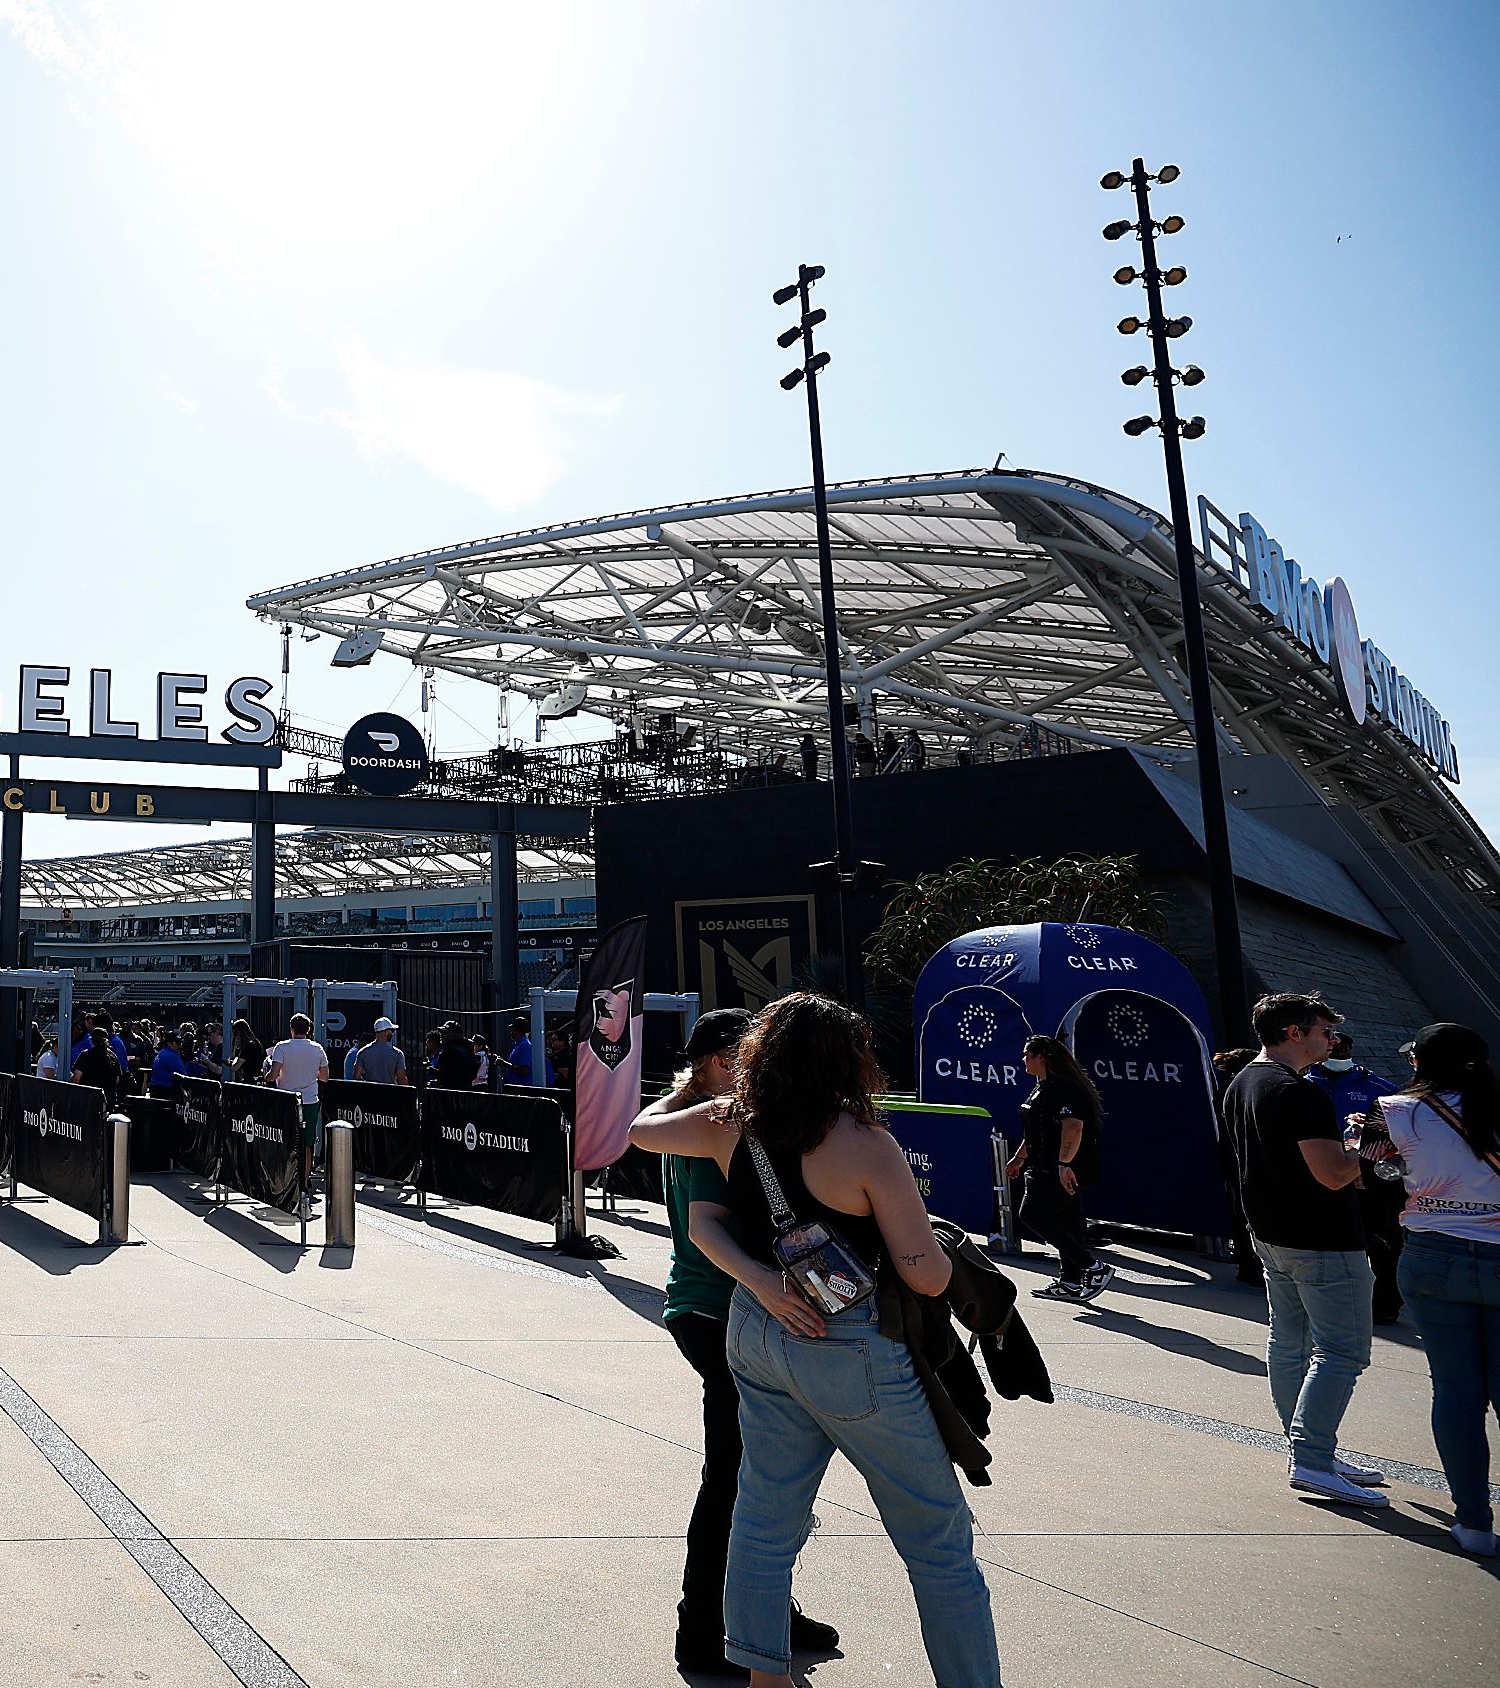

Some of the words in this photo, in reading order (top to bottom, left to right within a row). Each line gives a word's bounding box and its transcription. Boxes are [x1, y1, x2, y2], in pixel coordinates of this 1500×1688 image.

[1239, 512, 1330, 664] BMO
[1361, 638, 1460, 785] STADIUM
[350, 756, 421, 770] DOORDASH
[3, 787, 155, 816] CLUB
[698, 920, 725, 931] LOS
[726, 917, 789, 930] ANGELES
[956, 953, 1015, 968] CLEAR
[1067, 955, 1138, 972] CLEAR
[326, 1038, 359, 1048] RDAS
[935, 1058, 1018, 1086] CLEAR
[1093, 1060, 1183, 1083] CLEAR
[23, 1109, 39, 1127] BMO
[48, 1117, 83, 1142] STADIUM
[364, 1112, 398, 1129] STADIUM
[254, 1123, 284, 1144] STADIUM
[479, 1131, 530, 1153] STADIUM
[904, 1147, 933, 1171] ting,
[915, 1177, 931, 1197] ng
[1417, 1195, 1500, 1212] SPROUTS
[828, 1281, 855, 1296] ALTOIDS
